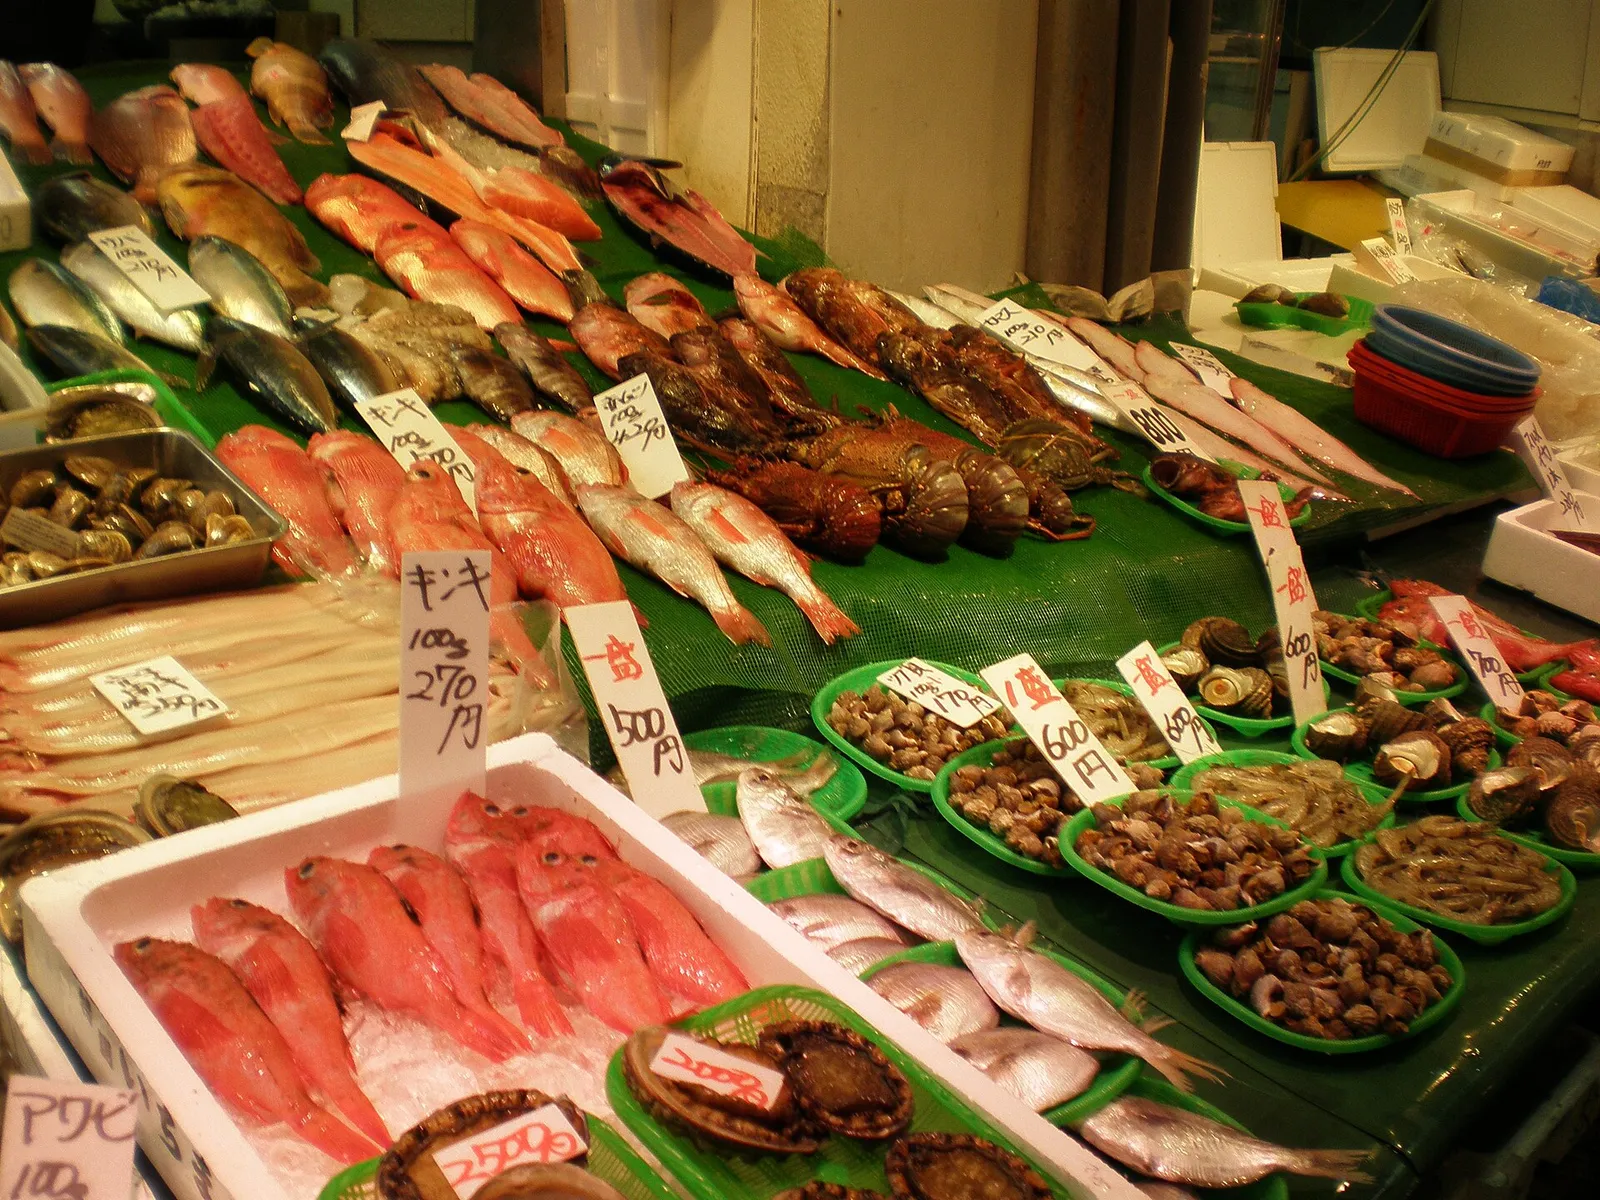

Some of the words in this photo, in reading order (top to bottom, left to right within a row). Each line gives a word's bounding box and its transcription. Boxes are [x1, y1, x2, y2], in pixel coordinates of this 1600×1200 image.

[1129, 407, 1187, 445] 800
[406, 557, 491, 613] キンキ
[408, 628, 471, 660] 100g
[1285, 625, 1311, 658] 600
[406, 664, 478, 708] 270
[437, 703, 484, 756] 円
[607, 703, 666, 747] 500
[1042, 719, 1090, 761] 600
[653, 735, 684, 777] 円
[1071, 749, 1119, 790] 円
[11, 1092, 139, 1145] アワビ
